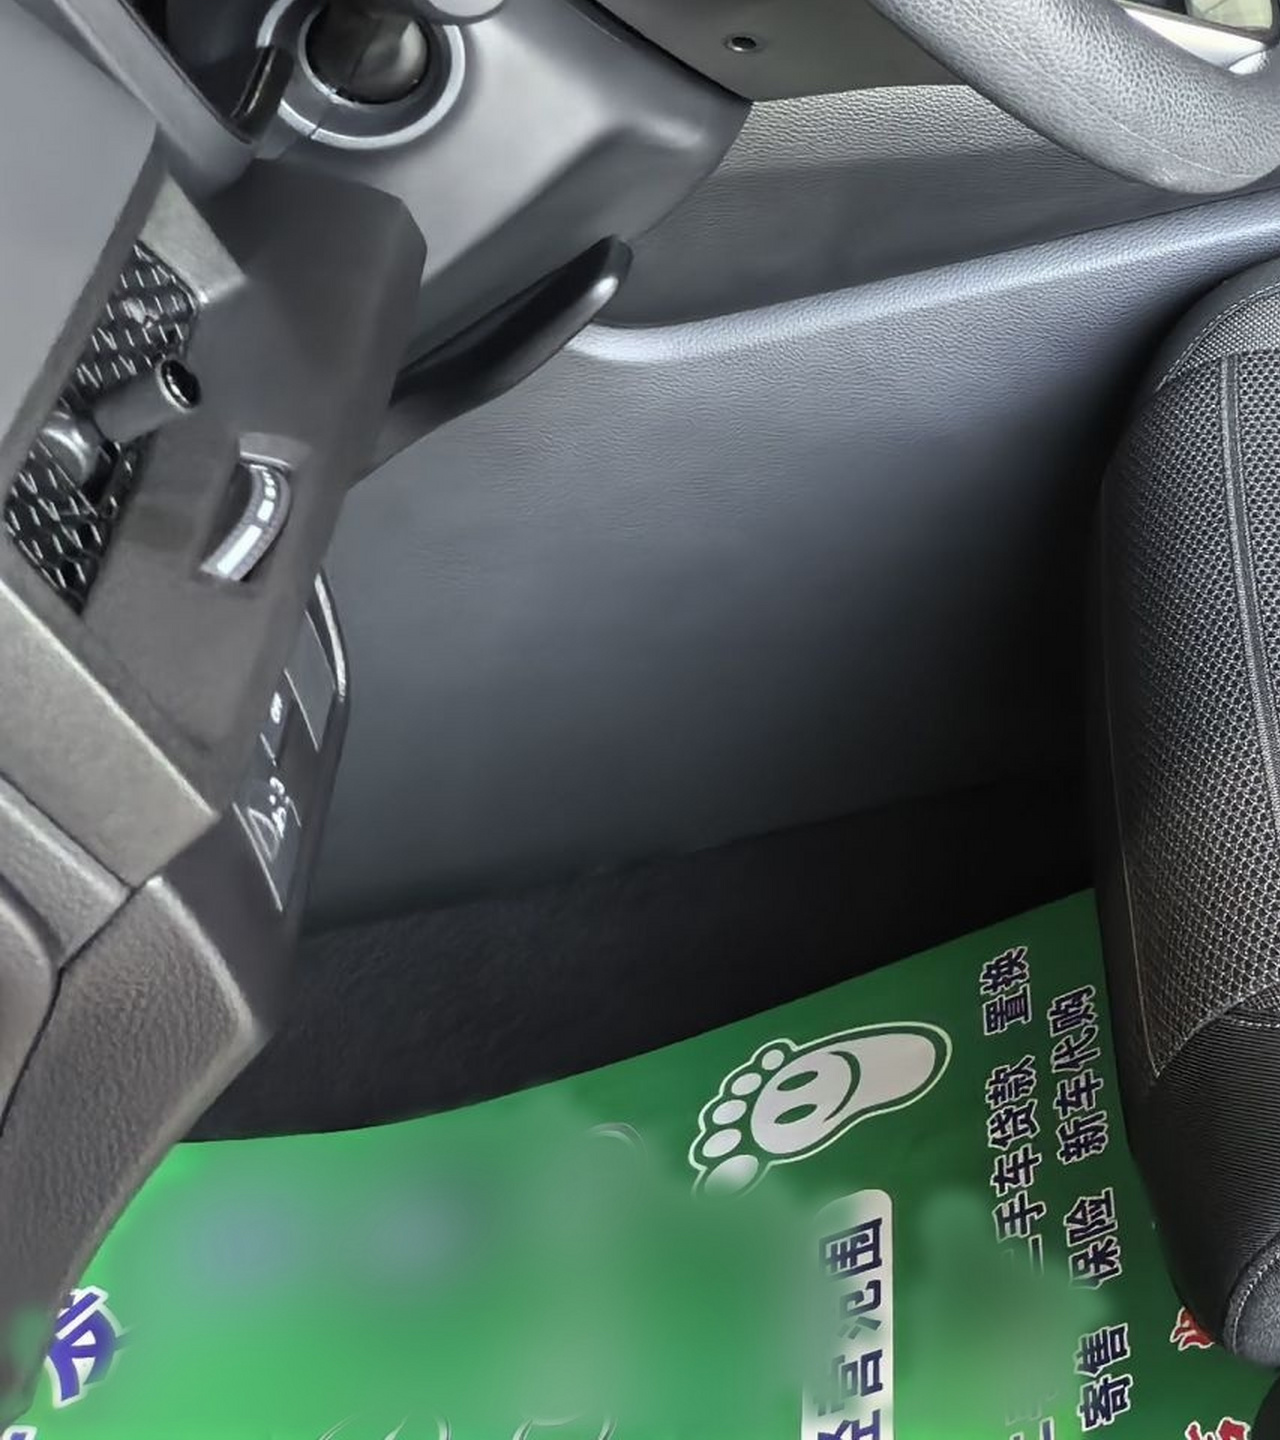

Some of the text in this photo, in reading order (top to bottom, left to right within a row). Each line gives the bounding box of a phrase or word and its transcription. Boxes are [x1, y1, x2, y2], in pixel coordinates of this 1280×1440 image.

[980, 946, 1032, 1035] 置换
[1047, 984, 1133, 1432] 寄售 保险 新车代购
